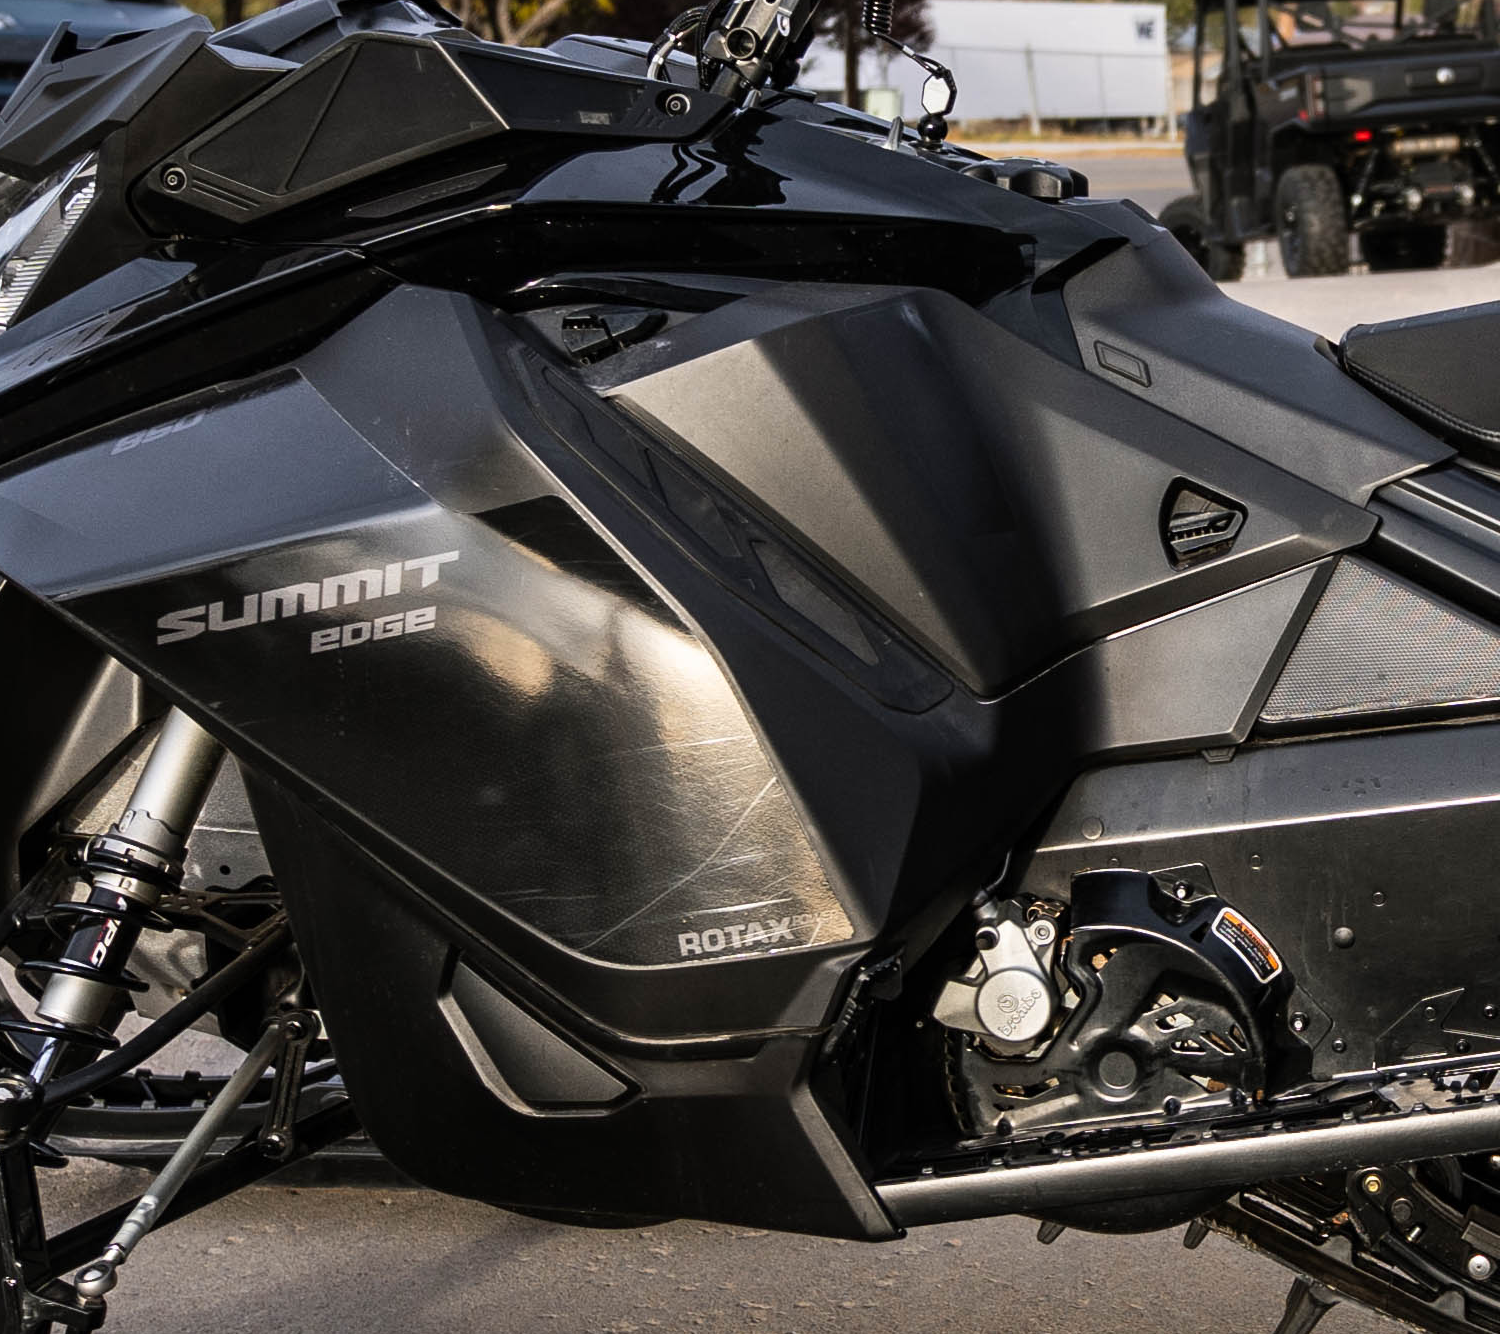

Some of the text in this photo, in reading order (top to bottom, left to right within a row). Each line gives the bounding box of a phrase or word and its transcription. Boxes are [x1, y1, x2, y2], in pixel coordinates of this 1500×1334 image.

[156, 550, 460, 646] SUMMIT
[677, 917, 795, 957] ROTAX
[997, 988, 1042, 1037] brembo
